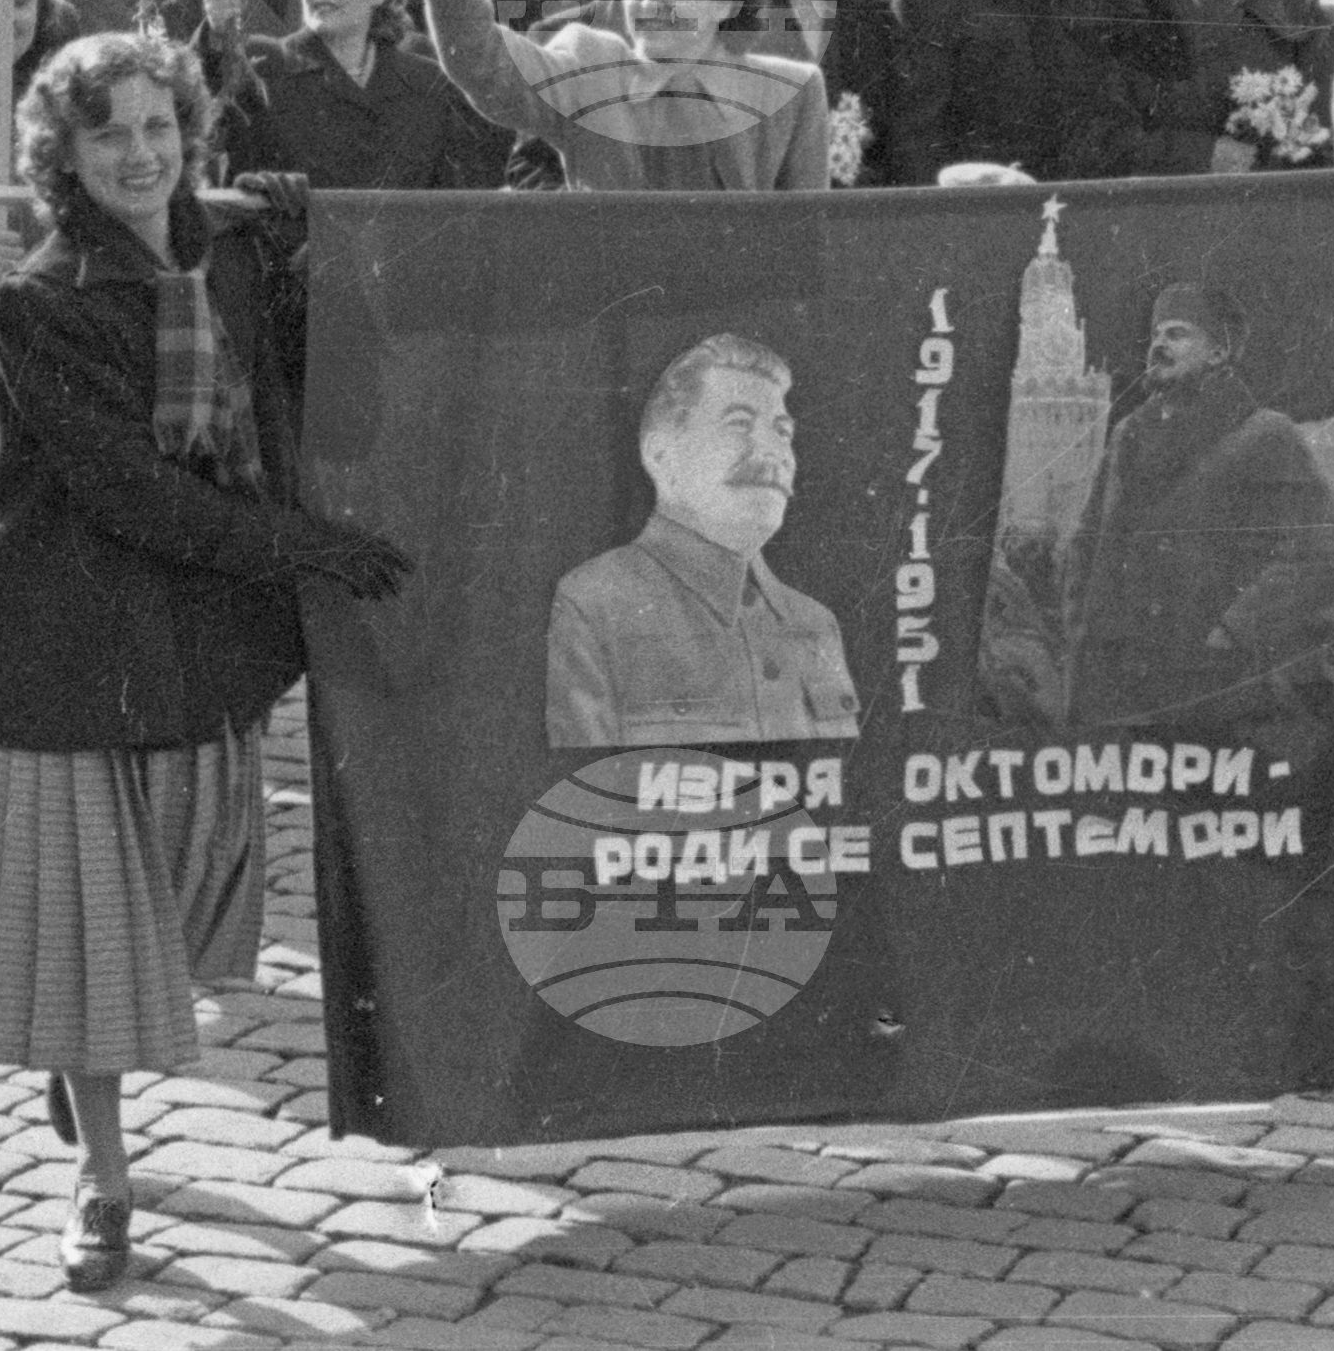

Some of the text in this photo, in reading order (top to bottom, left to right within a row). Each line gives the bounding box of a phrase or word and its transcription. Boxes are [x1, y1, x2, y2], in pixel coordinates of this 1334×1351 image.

[638, 758, 843, 814] ИЗГРЯ
[593, 806, 1305, 886] РОДИ СЕ СЕПТЕМВРИ
